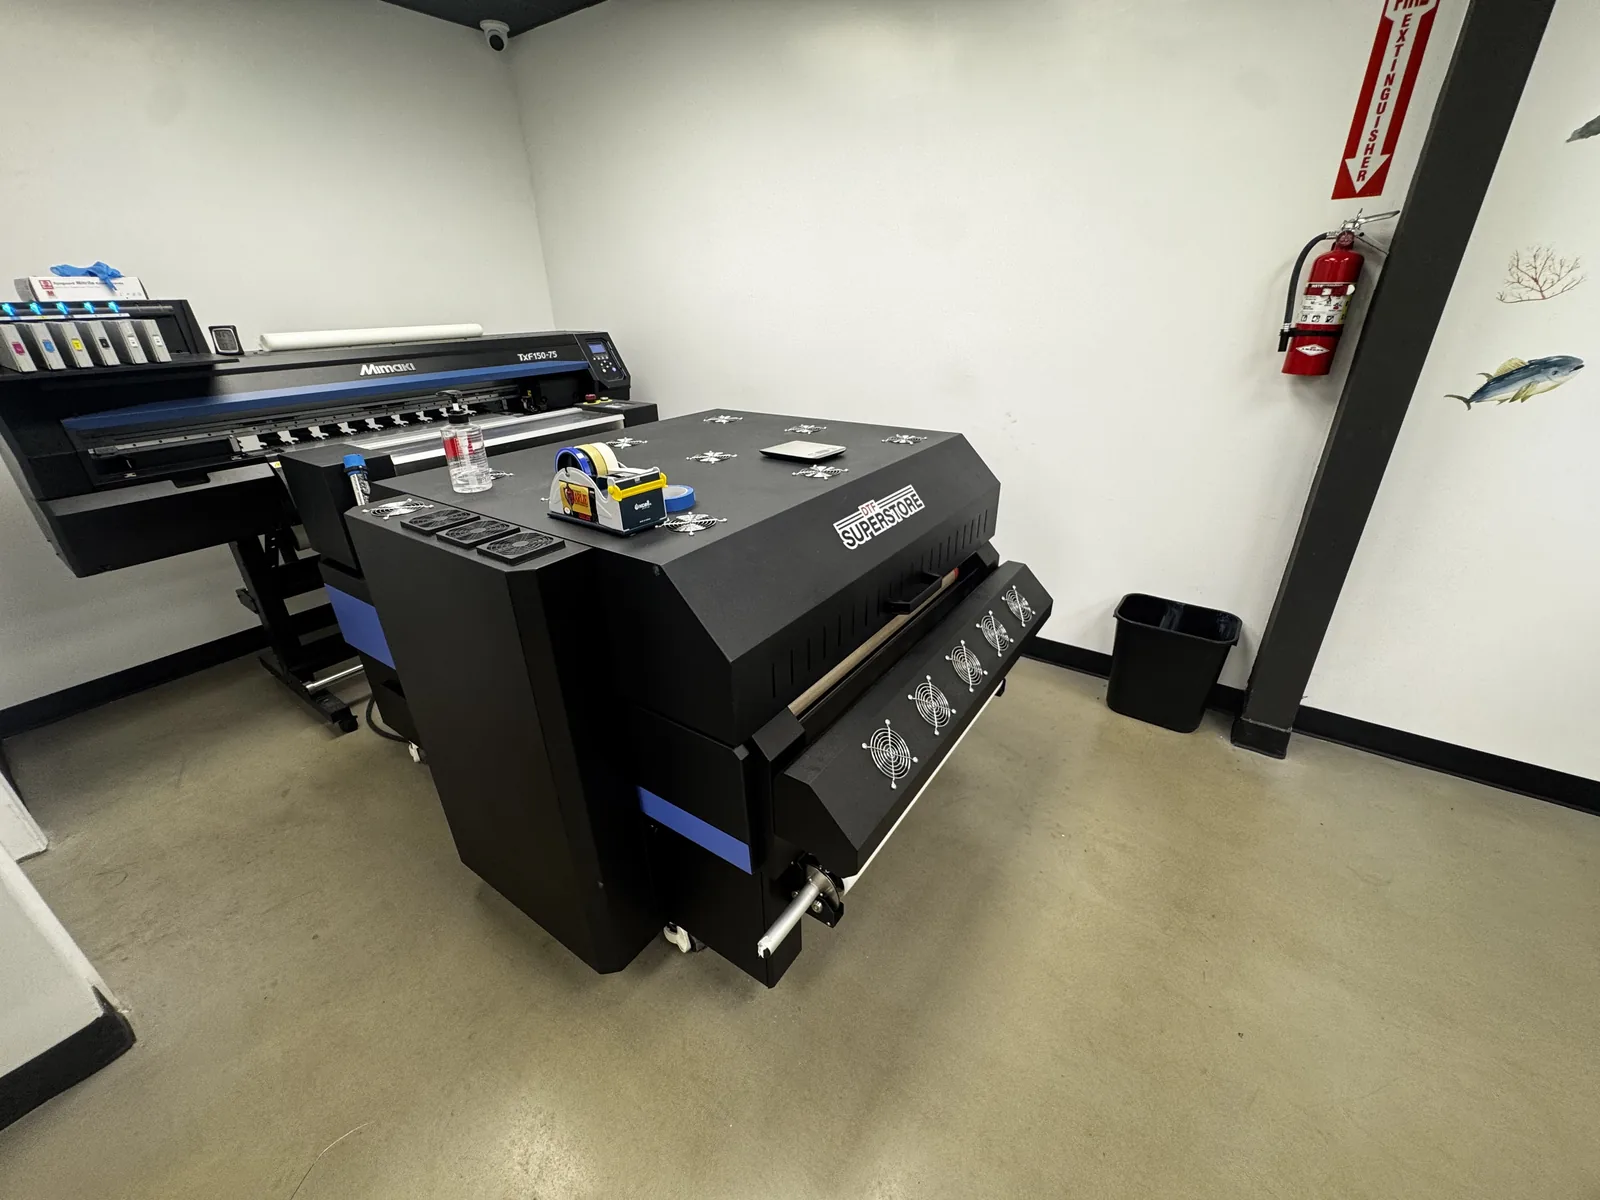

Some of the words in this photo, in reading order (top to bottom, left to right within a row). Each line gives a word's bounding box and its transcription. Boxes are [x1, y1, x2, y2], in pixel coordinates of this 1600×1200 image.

[1356, 13, 1412, 182] EXTINGUISHER
[517, 350, 558, 361] TxF150-75
[360, 362, 416, 376] Mimaki
[861, 502, 876, 516] DTF
[841, 493, 923, 547] SUPERSTORE
